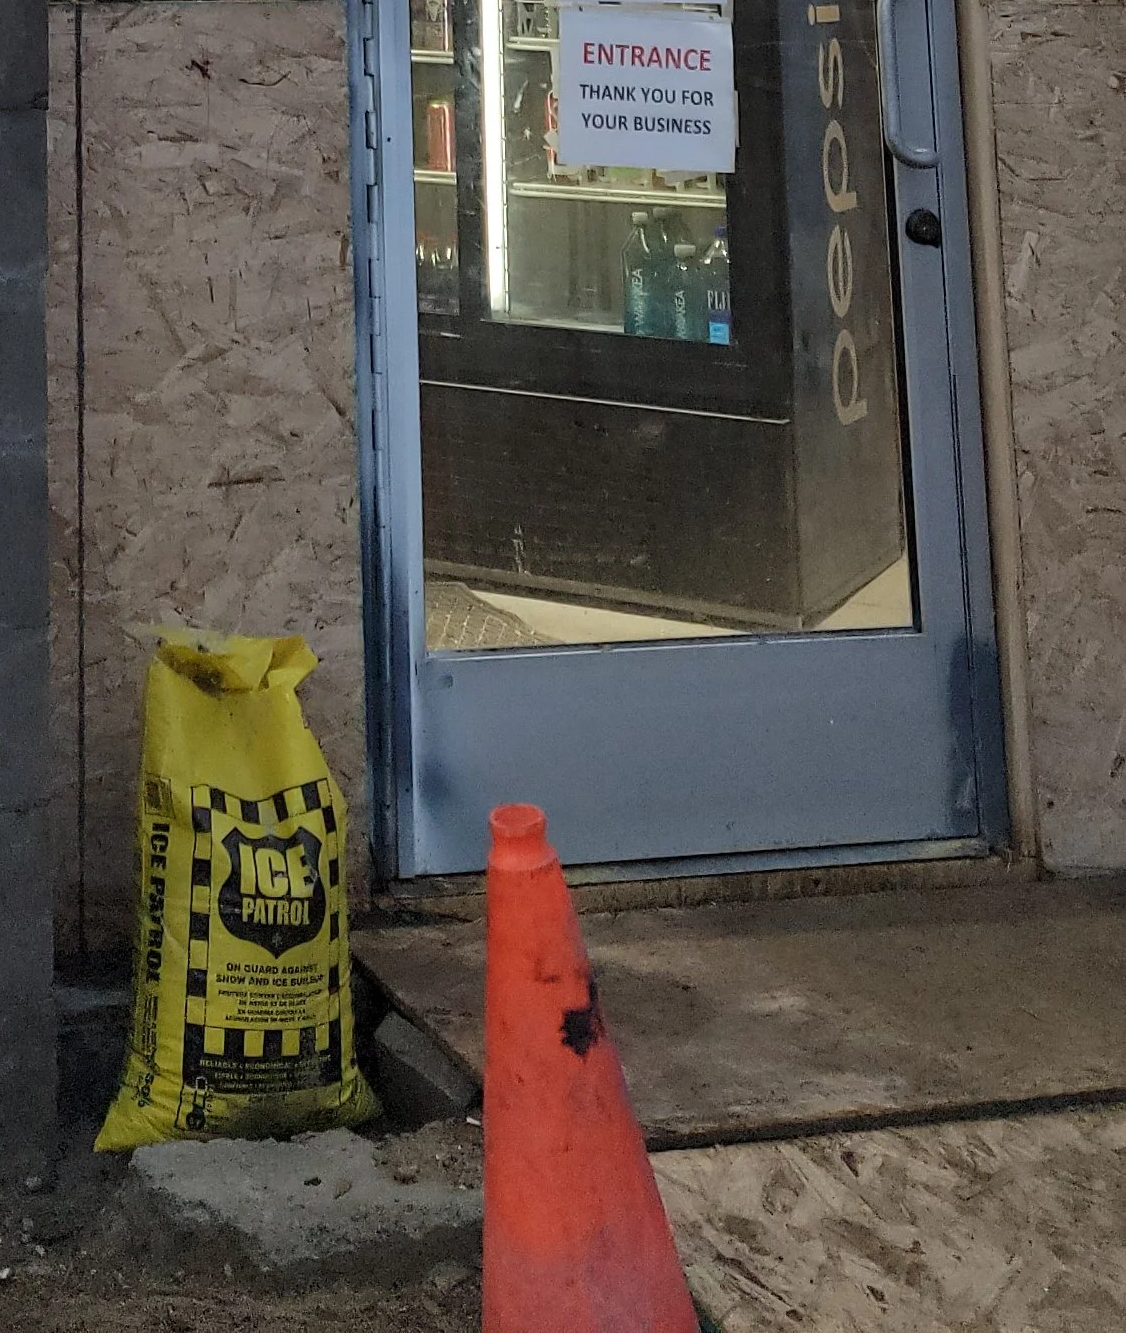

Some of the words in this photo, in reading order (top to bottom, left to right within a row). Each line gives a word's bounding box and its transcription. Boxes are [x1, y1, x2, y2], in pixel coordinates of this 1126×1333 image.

[582, 41, 712, 73] ENTRANCE
[580, 83, 636, 103] THANK
[640, 86, 678, 105] YOU
[681, 88, 714, 107] FOR
[581, 112, 629, 132] YOUR
[633, 114, 713, 136] BUSINESS
[807, 2, 868, 427] pepsi
[150, 822, 171, 871] ICE
[238, 843, 318, 897] ICE
[241, 897, 311, 926] PATROL
[216, 974, 246, 984] SNOW
[248, 976, 270, 986] AND
[273, 977, 288, 987] ICE
[226, 962, 241, 972] ON
[244, 964, 278, 974] GUARD
